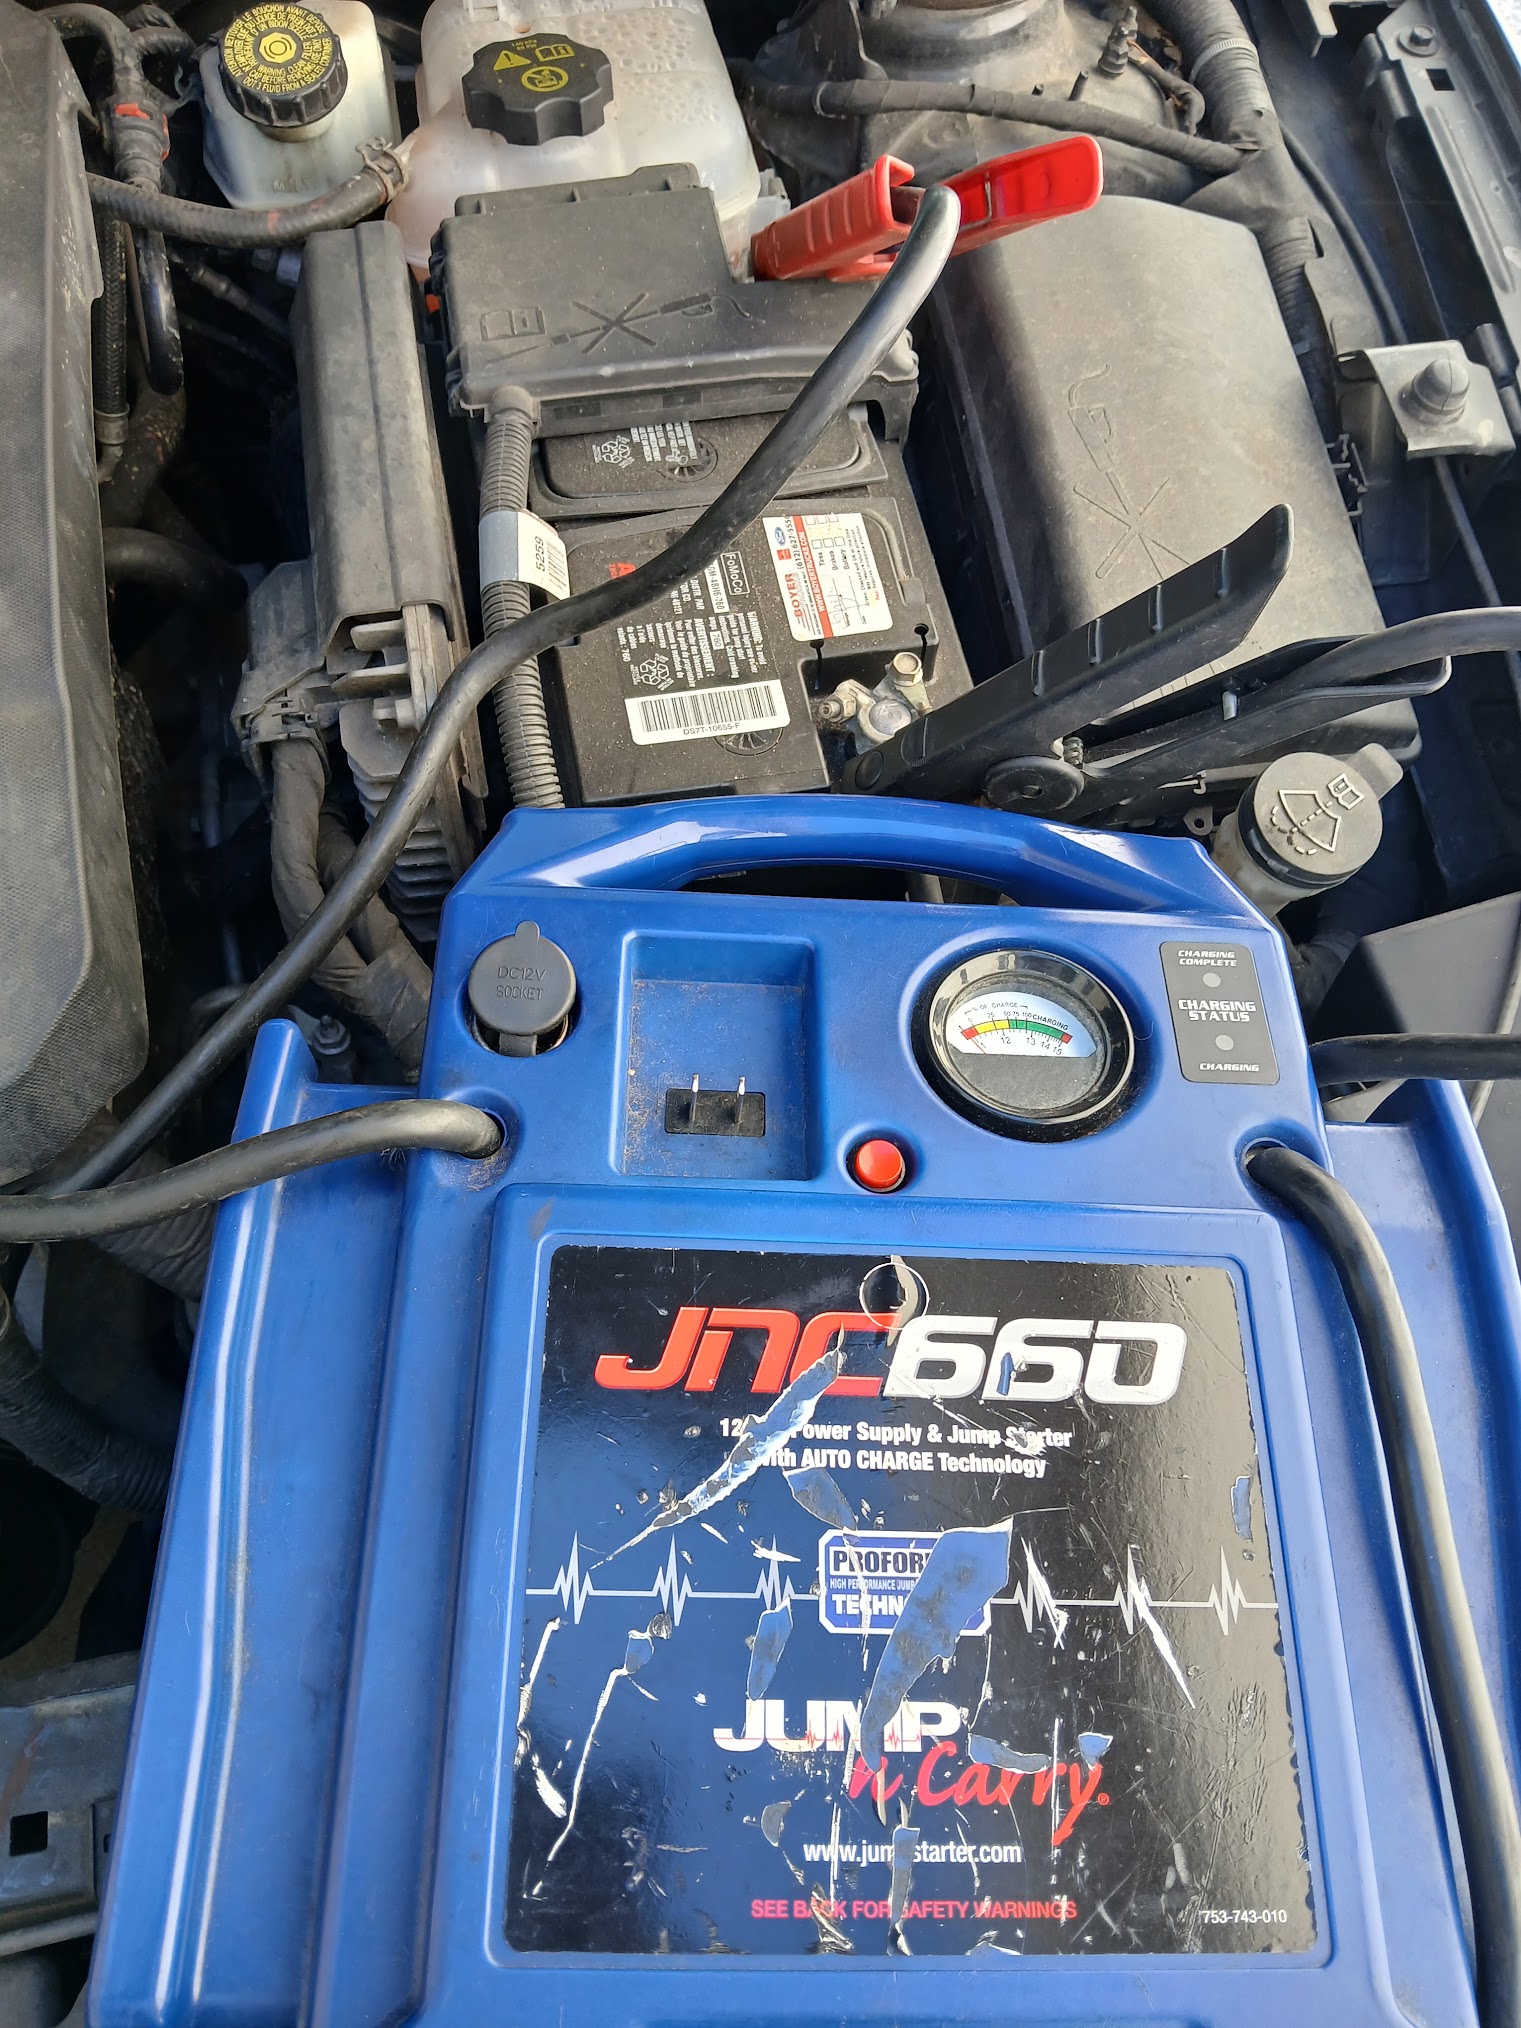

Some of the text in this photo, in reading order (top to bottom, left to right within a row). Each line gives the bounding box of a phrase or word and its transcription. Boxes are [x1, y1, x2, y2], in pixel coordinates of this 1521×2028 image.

[252, 4, 284, 16] BOUCHON
[286, 6, 307, 18] AVANT
[268, 20, 289, 29] BIDON
[257, 64, 286, 76] WARNING
[287, 60, 307, 74] CLEAN
[243, 77, 256, 88] DOT
[262, 84, 281, 93] FLUID
[281, 81, 301, 92] FROM
[248, 71, 262, 79] CAP
[261, 75, 287, 85] BEFORE
[535, 535, 546, 572] 5259
[793, 549, 804, 569] (612)
[725, 553, 744, 594] FoMoCo
[785, 573, 802, 617] BOYER
[747, 611, 762, 644] WARNING:
[694, 617, 714, 672] AVERTISSEMENT
[712, 633, 721, 647] 760
[621, 648, 629, 662] 760
[682, 721, 741, 737] DS7T-10655-F
[1178, 949, 1235, 958] CHARGING
[1179, 958, 1237, 967] COMPLETE
[497, 965, 547, 981] DC12V
[496, 984, 543, 1000] SOCKET
[1178, 999, 1256, 1012] CHARGING
[1032, 1014, 1069, 1031] CHARGING
[1189, 1010, 1250, 1022] STATUS
[1001, 1036, 1063, 1056] 12 13 14 15
[1199, 1062, 1260, 1072] CHARGING
[790, 1422, 852, 1441] ower
[856, 1421, 922, 1446] Supply
[927, 1423, 943, 1443] &
[946, 1424, 1001, 1448] Jump
[800, 1448, 851, 1469] AUTO
[856, 1449, 934, 1471] CHARGE
[937, 1452, 1047, 1479] Technology
[833, 1550, 930, 1574] PROFOR
[829, 1577, 847, 1590] HIGH
[847, 1578, 896, 1591] PERORMANCE
[831, 1593, 906, 1616] TECHN
[803, 1839, 1022, 1868] www.jumstarter.com
[751, 1899, 788, 1919] SEE
[852, 1900, 891, 1919] FOR
[974, 1900, 1077, 1920] WARNINGS
[1202, 1908, 1288, 1924] 753-743-010
